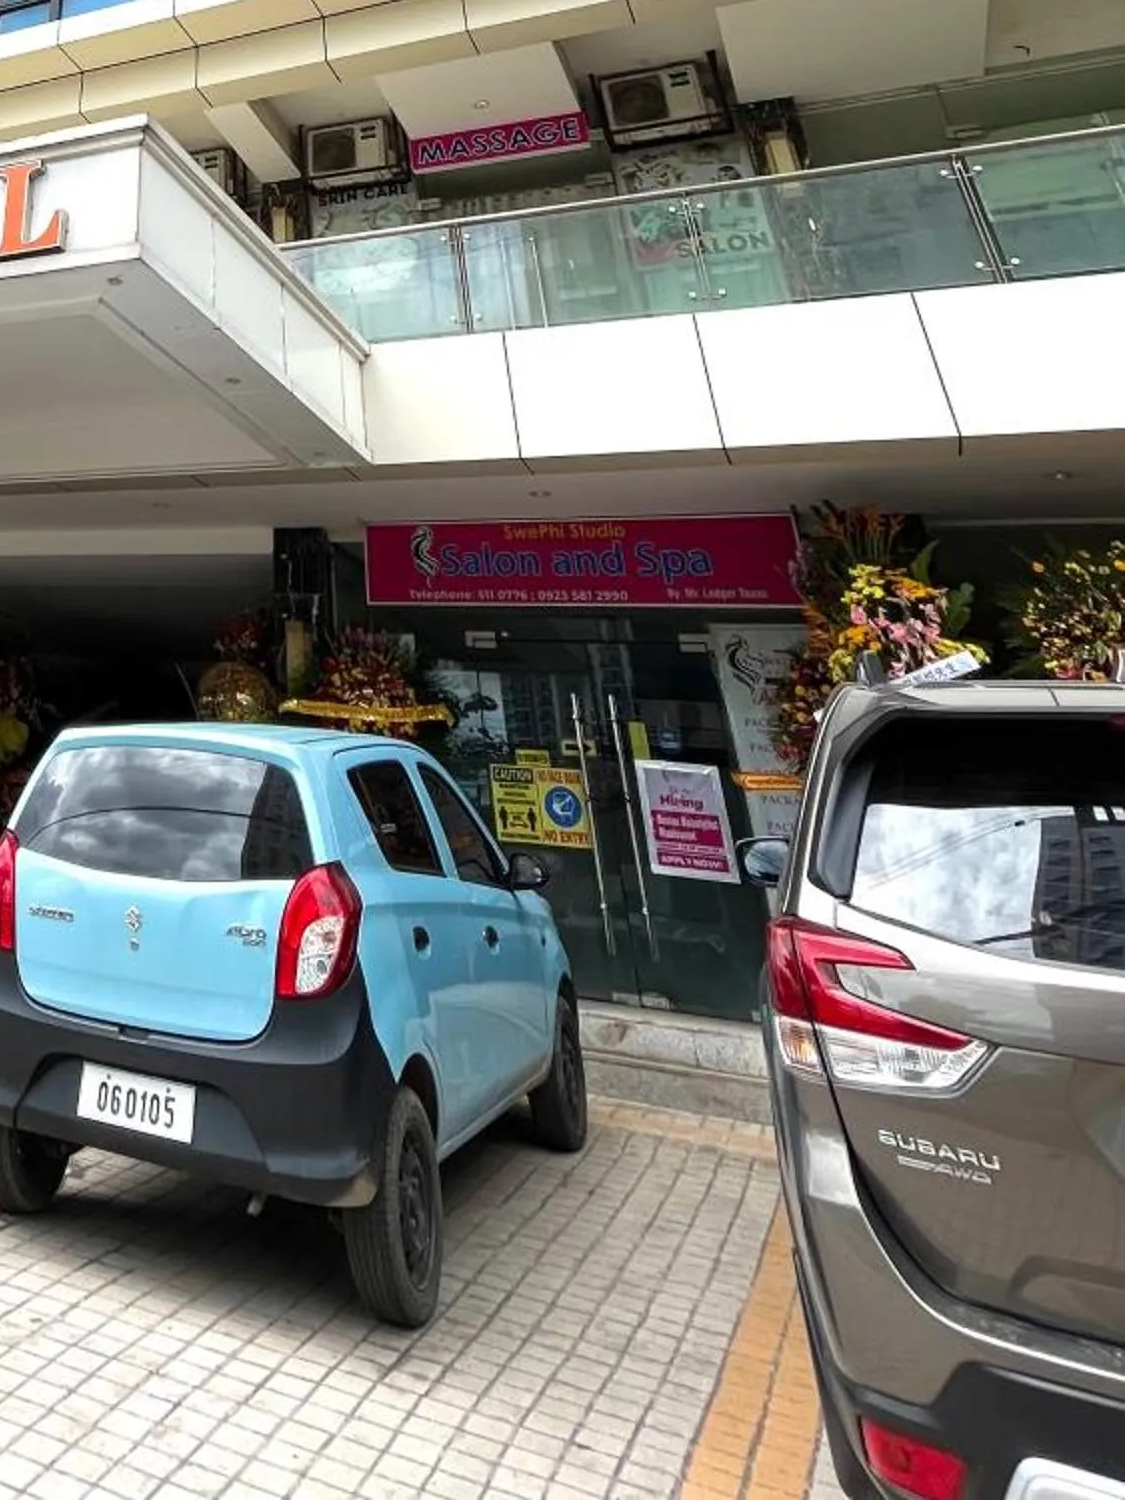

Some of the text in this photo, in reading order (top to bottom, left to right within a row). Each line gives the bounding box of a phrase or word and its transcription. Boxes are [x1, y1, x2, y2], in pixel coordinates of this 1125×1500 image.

[418, 119, 580, 164] MASSAGE
[570, 522, 626, 539] Studio
[441, 541, 713, 585] Salon and Spa
[494, 768, 533, 783] CAUTION
[659, 792, 704, 811] Hiring
[97, 1080, 176, 1129] 060105
[877, 1128, 1002, 1171] SUBARU
